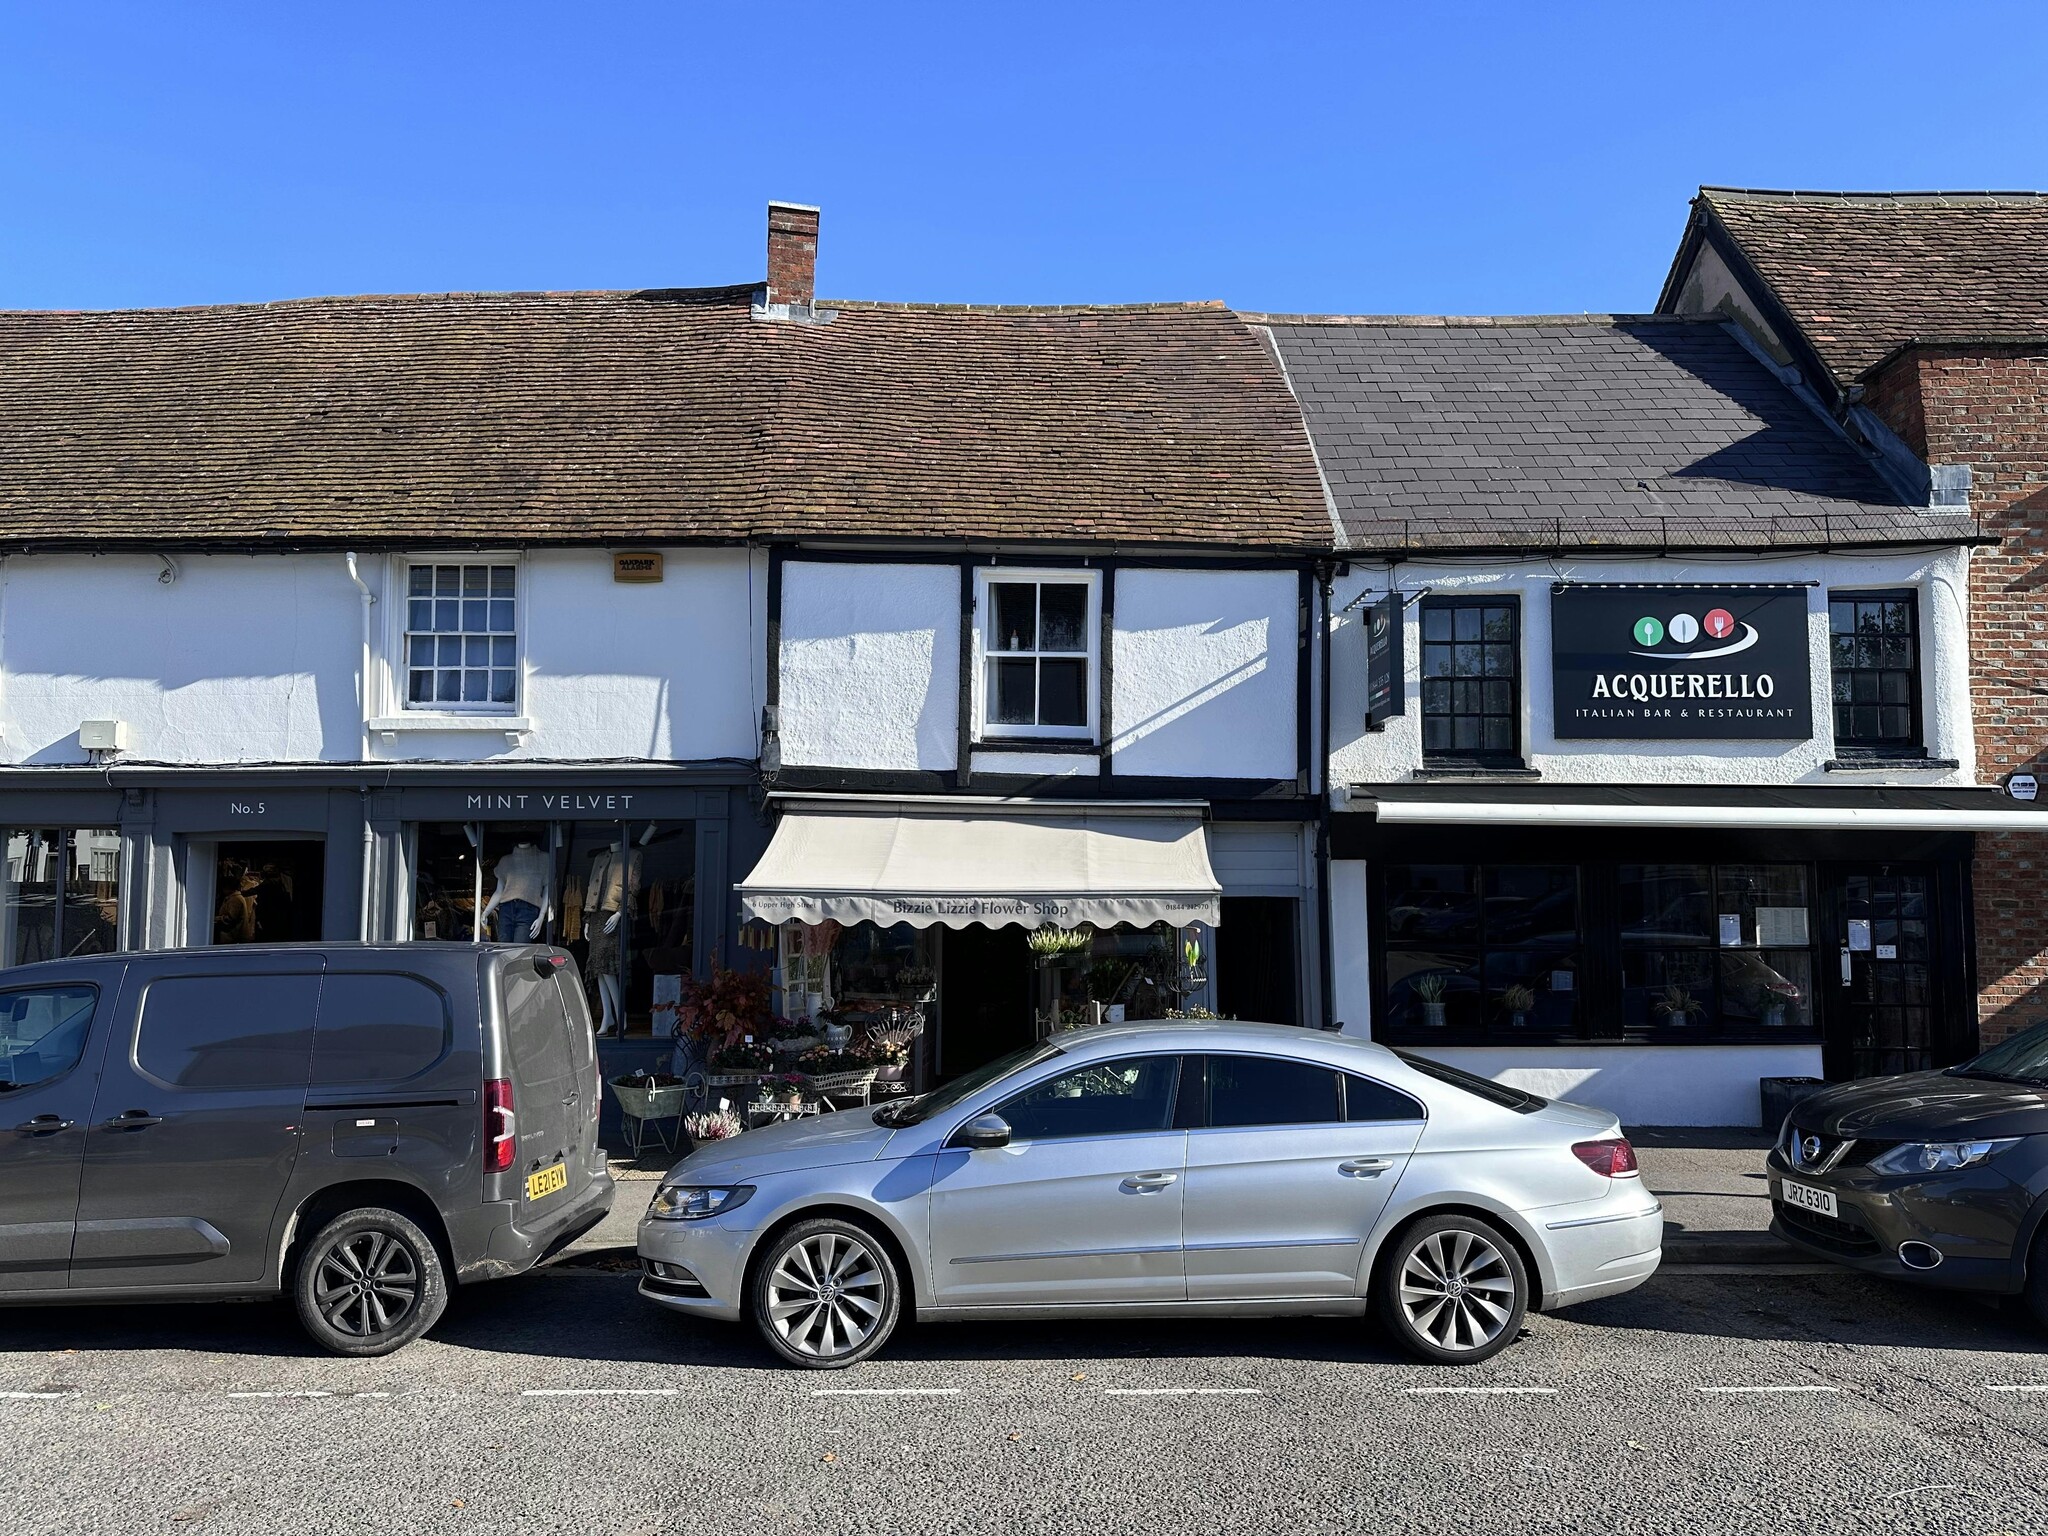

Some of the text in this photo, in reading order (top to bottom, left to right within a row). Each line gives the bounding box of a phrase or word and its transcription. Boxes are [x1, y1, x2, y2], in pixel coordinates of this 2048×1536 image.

[1592, 674, 1774, 702] ACQUERELLO
[1576, 708, 1794, 718] ITALIAN BAR & RESTAURANT
[467, 795, 633, 809] MINT VELVET
[231, 803, 266, 814] No. 5
[1882, 865, 1890, 876] 7
[758, 901, 779, 909] Upper
[780, 901, 796, 910] High
[797, 901, 817, 909] Street
[893, 901, 1069, 918] Bizzie Lizzie Flower Shop
[1788, 1183, 1830, 1211] JRZ 6310
